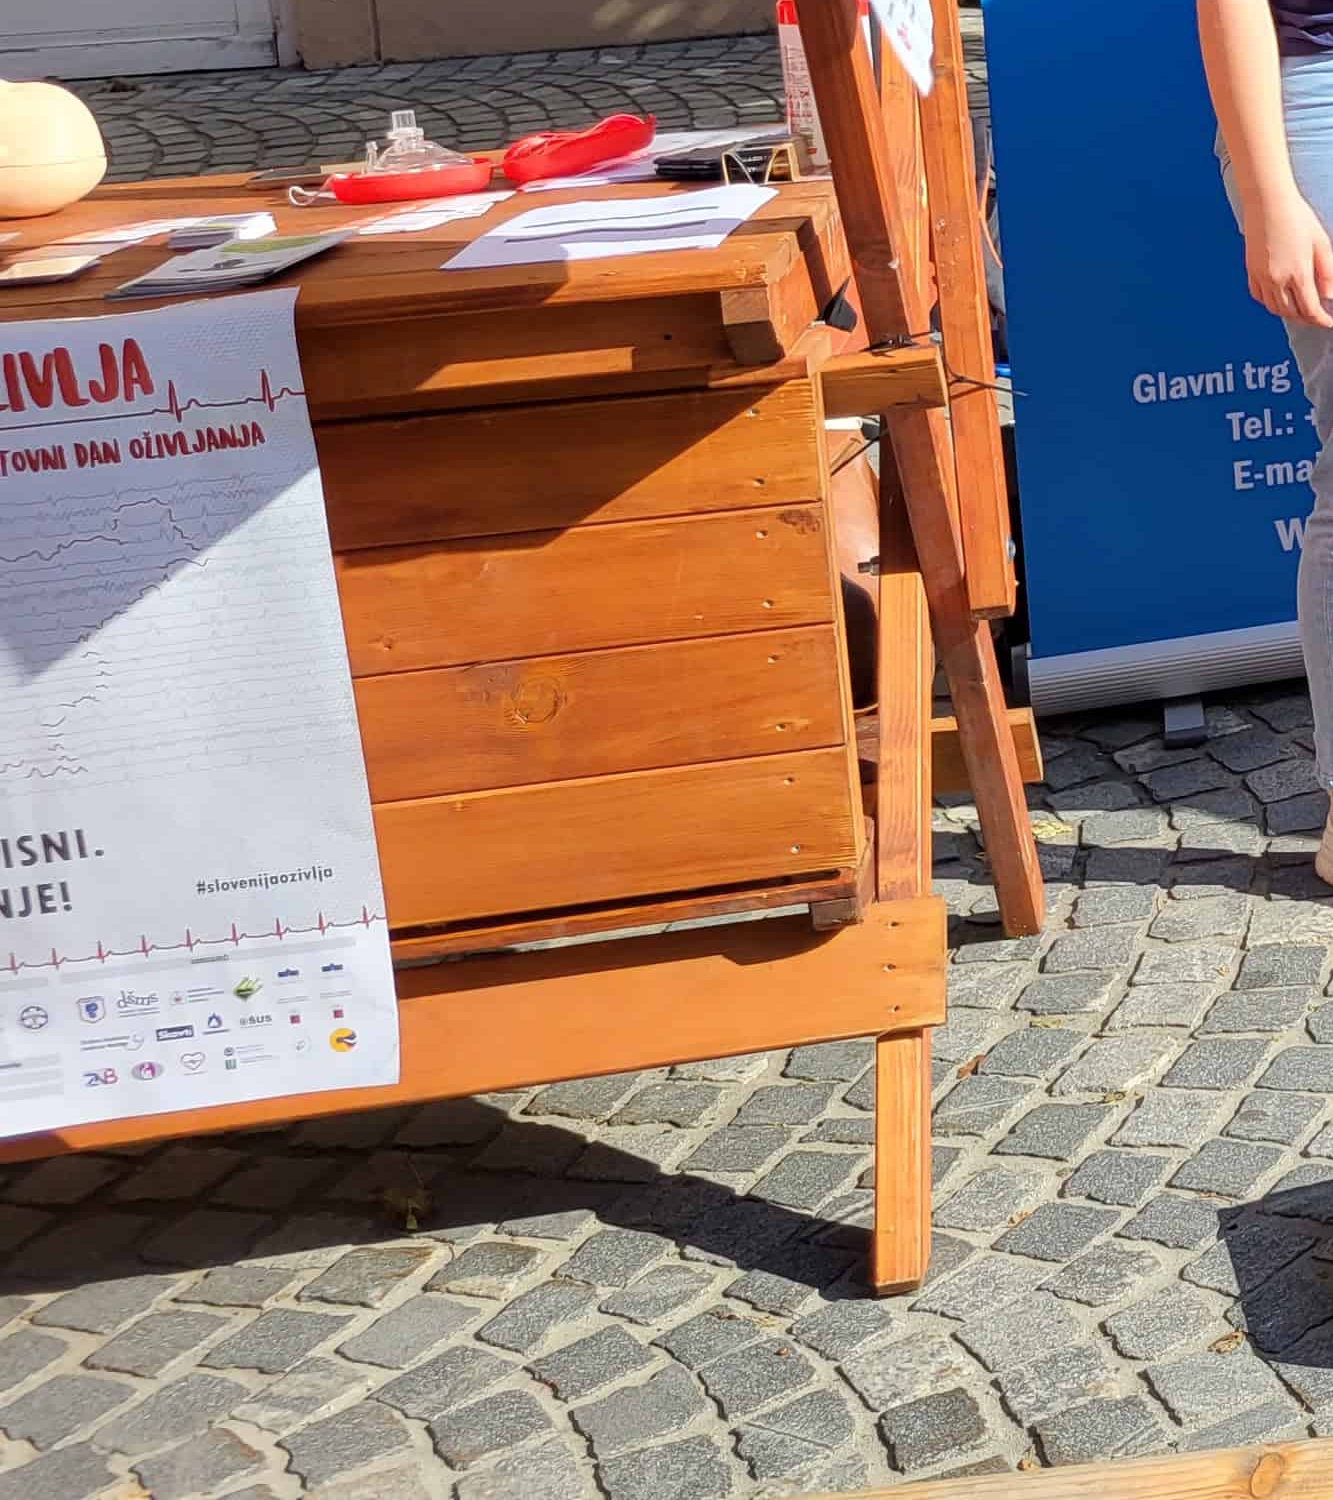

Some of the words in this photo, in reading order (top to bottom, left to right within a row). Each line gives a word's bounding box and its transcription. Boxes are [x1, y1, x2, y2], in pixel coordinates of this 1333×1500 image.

[0, 338, 154, 412] IVLJA
[1132, 363, 1235, 403] Glavni
[1243, 360, 1291, 393] trg
[73, 438, 121, 468] DAN
[129, 421, 265, 459] OŽIVLJANJA
[1225, 408, 1295, 441] Tel.:
[1233, 452, 1319, 490] E-ma
[196, 866, 333, 895] #slovenijaozivlja
